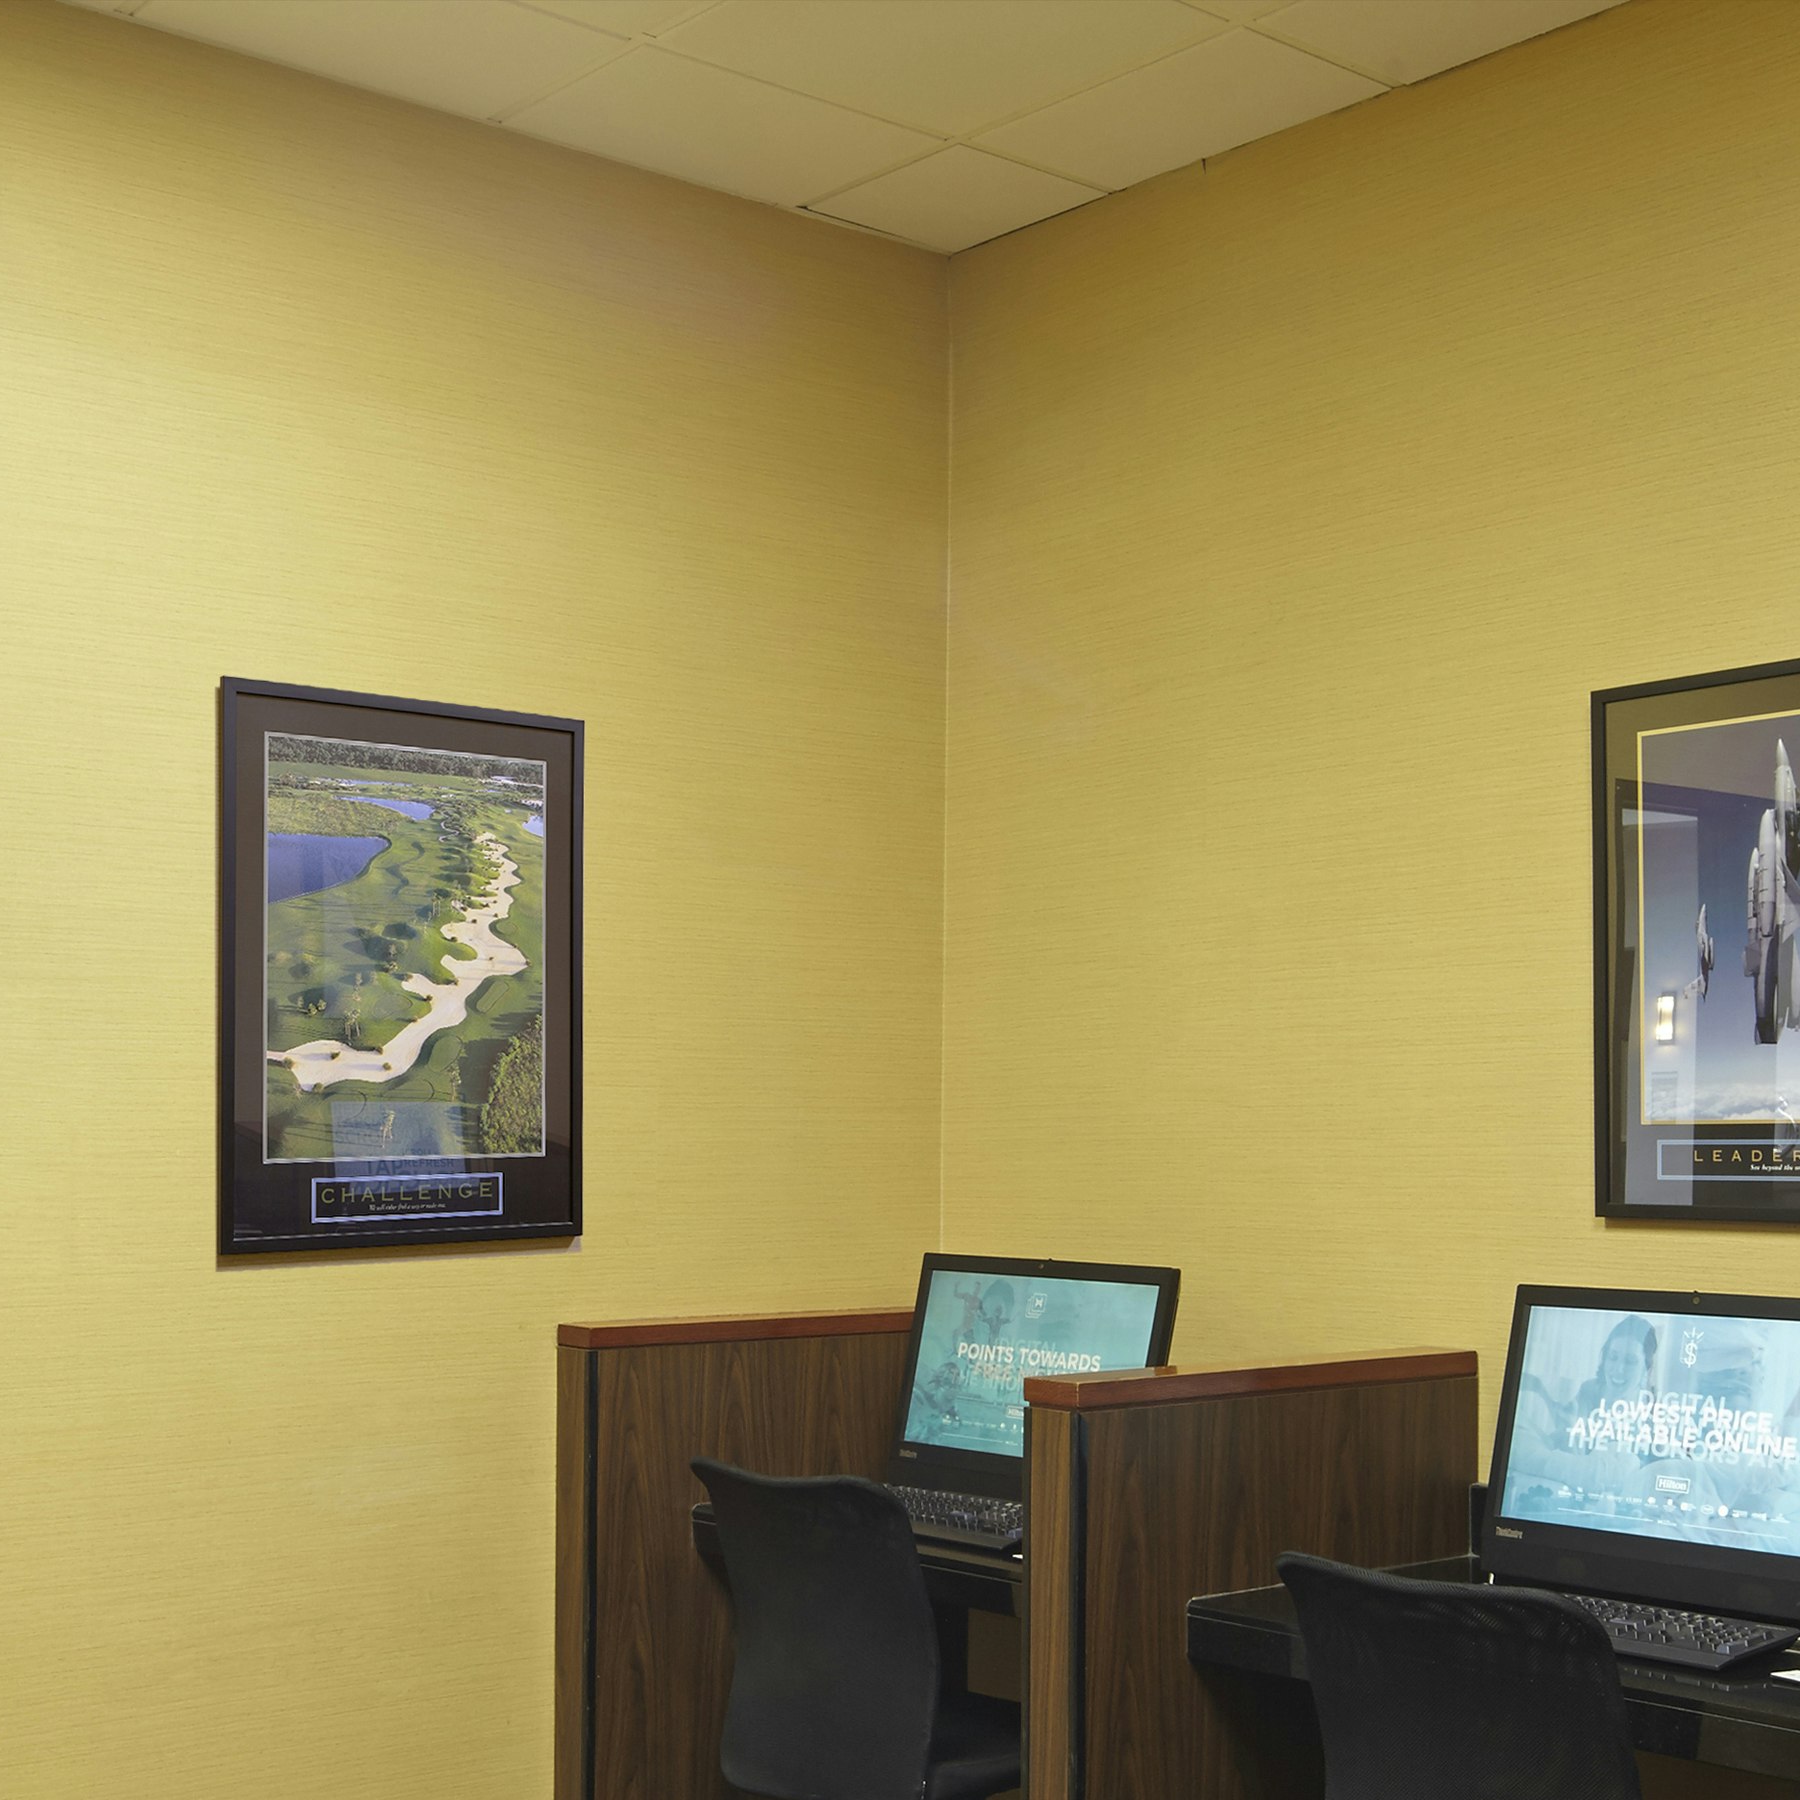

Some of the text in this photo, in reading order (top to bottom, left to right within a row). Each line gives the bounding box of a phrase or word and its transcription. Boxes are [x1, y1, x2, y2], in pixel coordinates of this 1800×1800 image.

[1762, 1164, 1782, 1173] beyond
[321, 1182, 493, 1204] CHALLENGE
[957, 1342, 1102, 1372] POINTS TOWARDS
[1598, 1398, 1696, 1426] LOWEST
[1700, 1408, 1774, 1433] PRICE
[1570, 1417, 1698, 1448] AVAILABLE
[1704, 1429, 1798, 1457] ONLINE
[1658, 1478, 1688, 1491] Hilton
